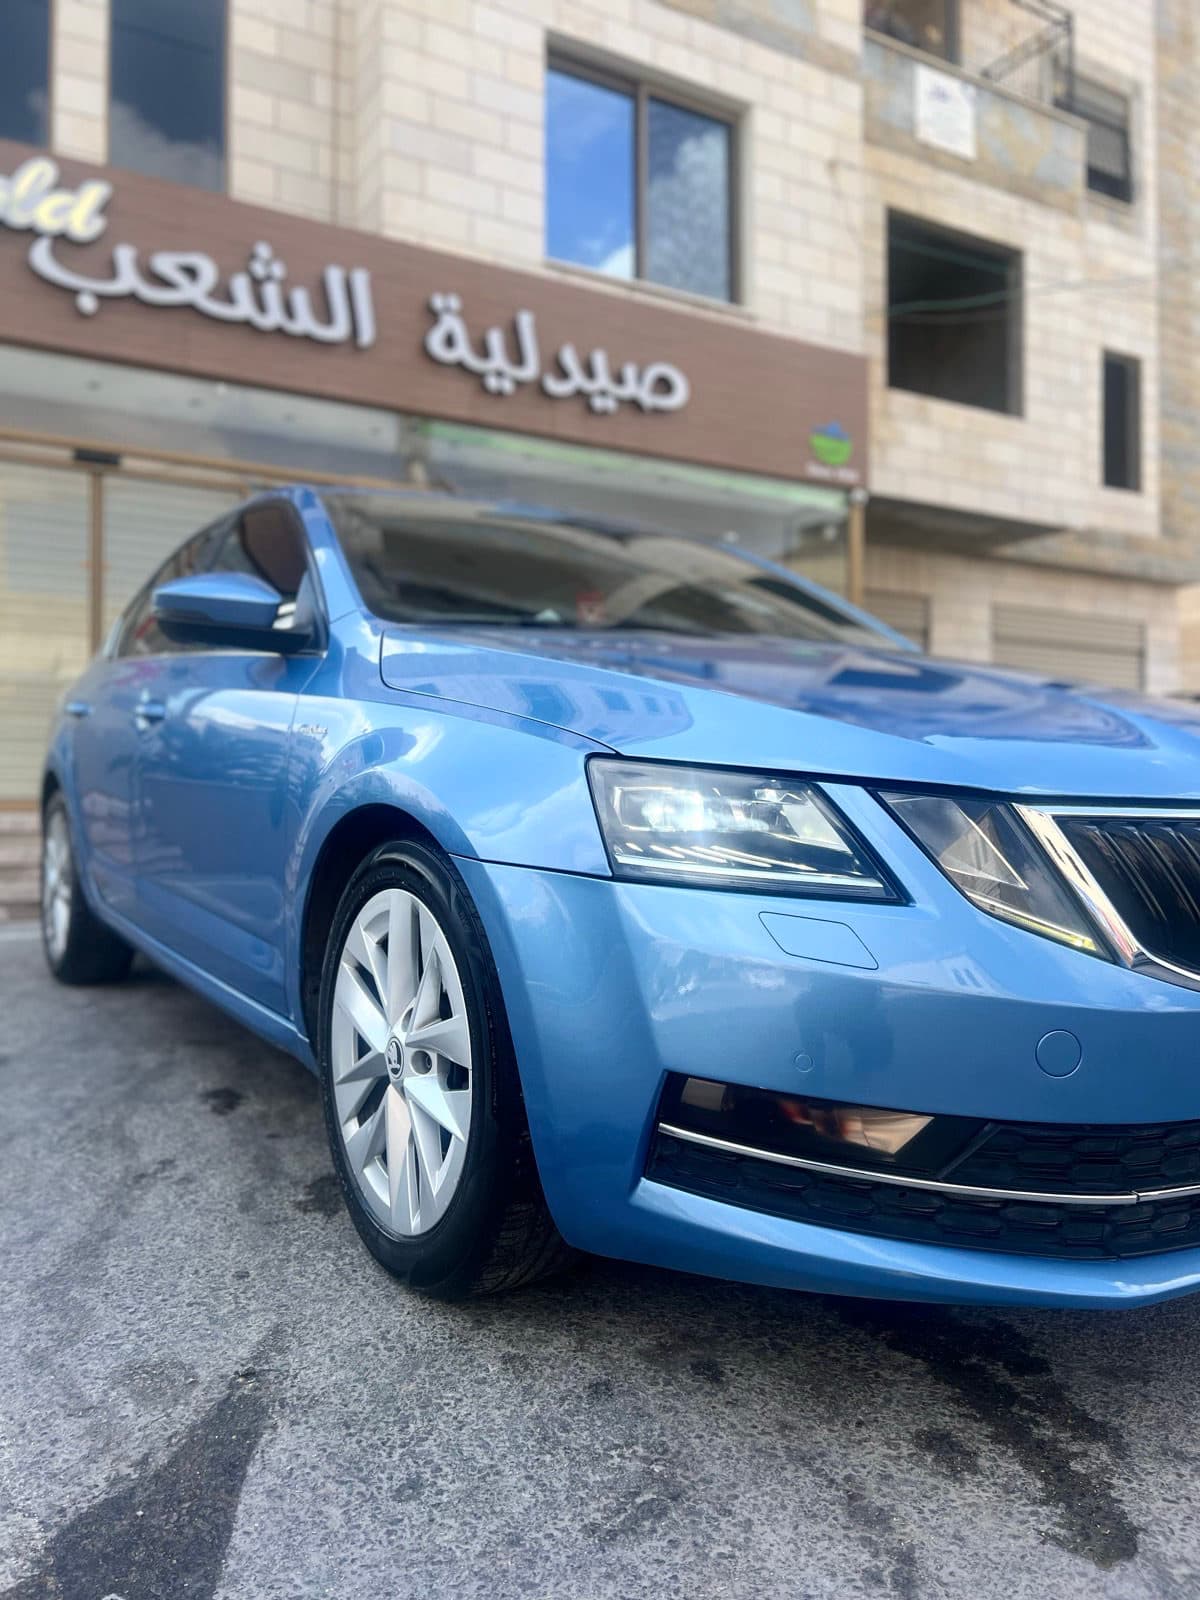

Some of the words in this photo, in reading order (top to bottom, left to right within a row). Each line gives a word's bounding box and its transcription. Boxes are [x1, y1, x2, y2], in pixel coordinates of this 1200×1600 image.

[0, 157, 111, 242] ld
[28, 240, 376, 349] الشعب
[425, 293, 691, 413] صيدلية
